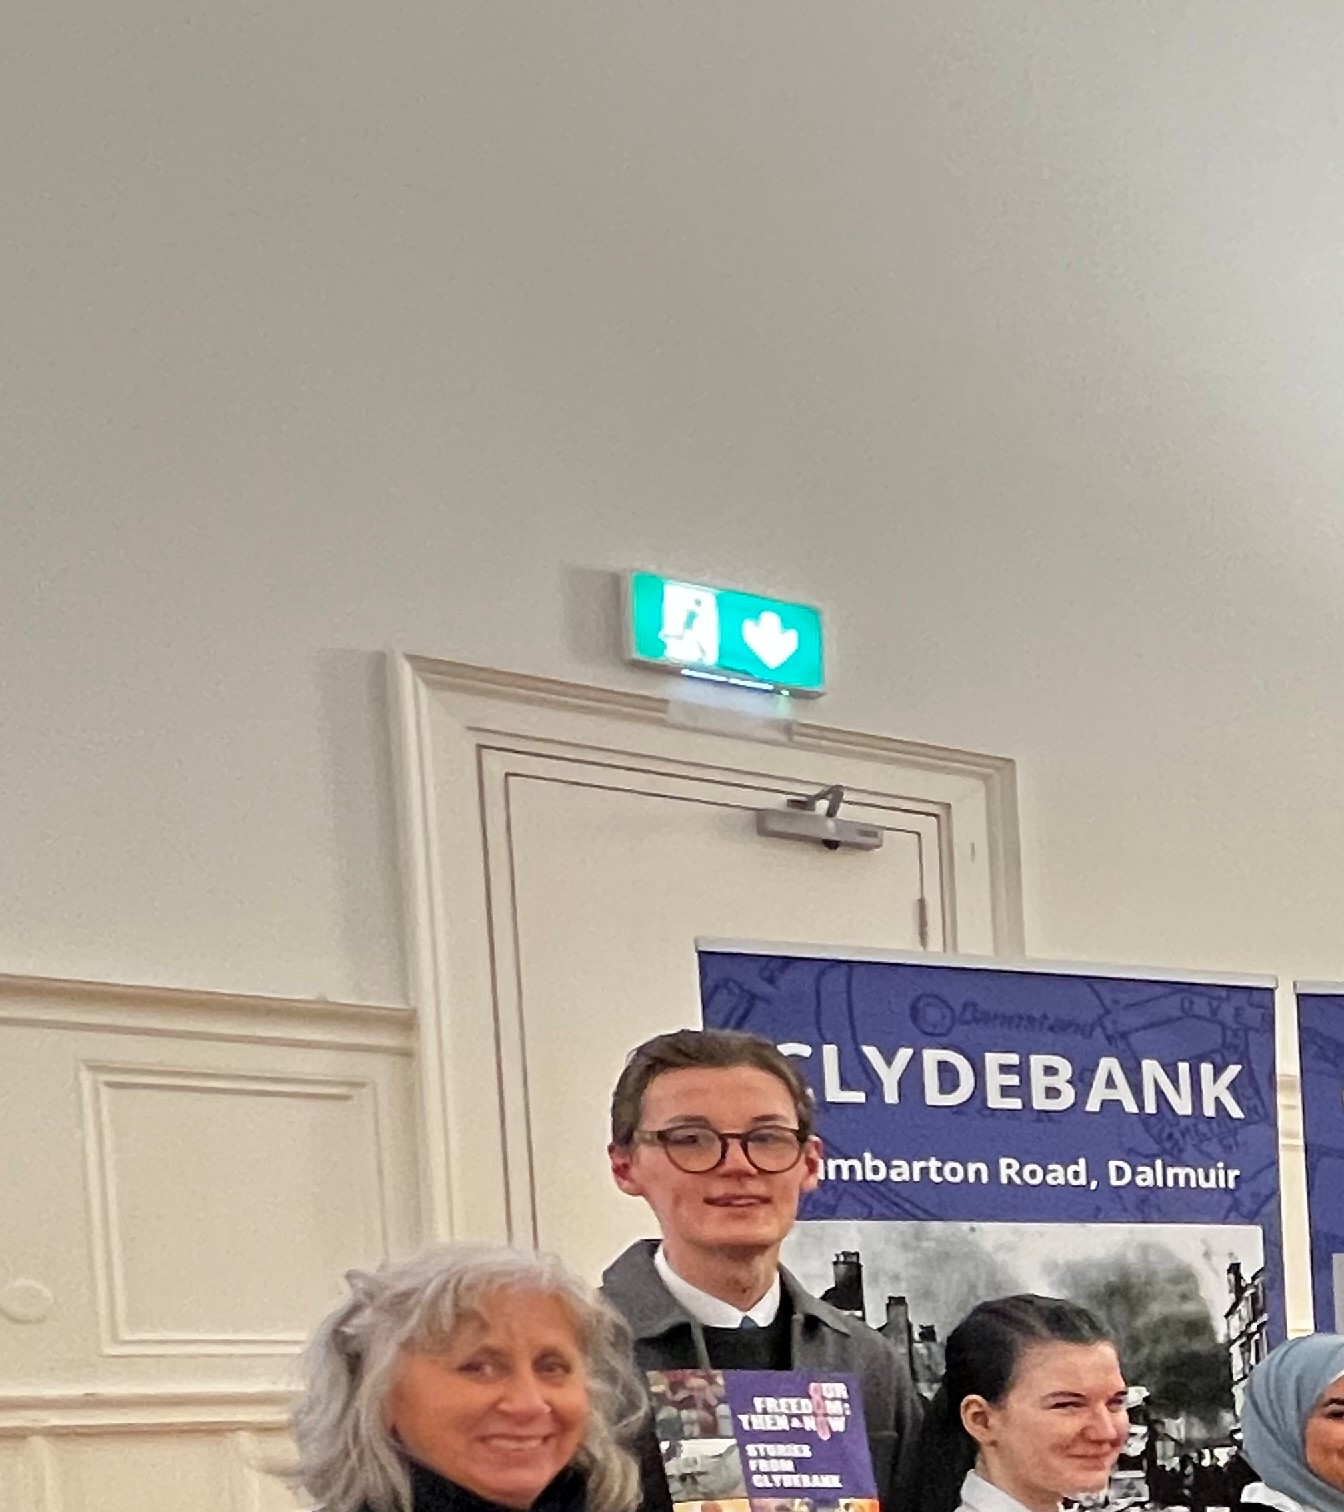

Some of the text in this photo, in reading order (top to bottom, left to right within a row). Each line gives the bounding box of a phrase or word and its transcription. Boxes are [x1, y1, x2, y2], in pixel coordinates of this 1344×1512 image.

[817, 1151, 1241, 1191] mbarton Road, Dalmuir
